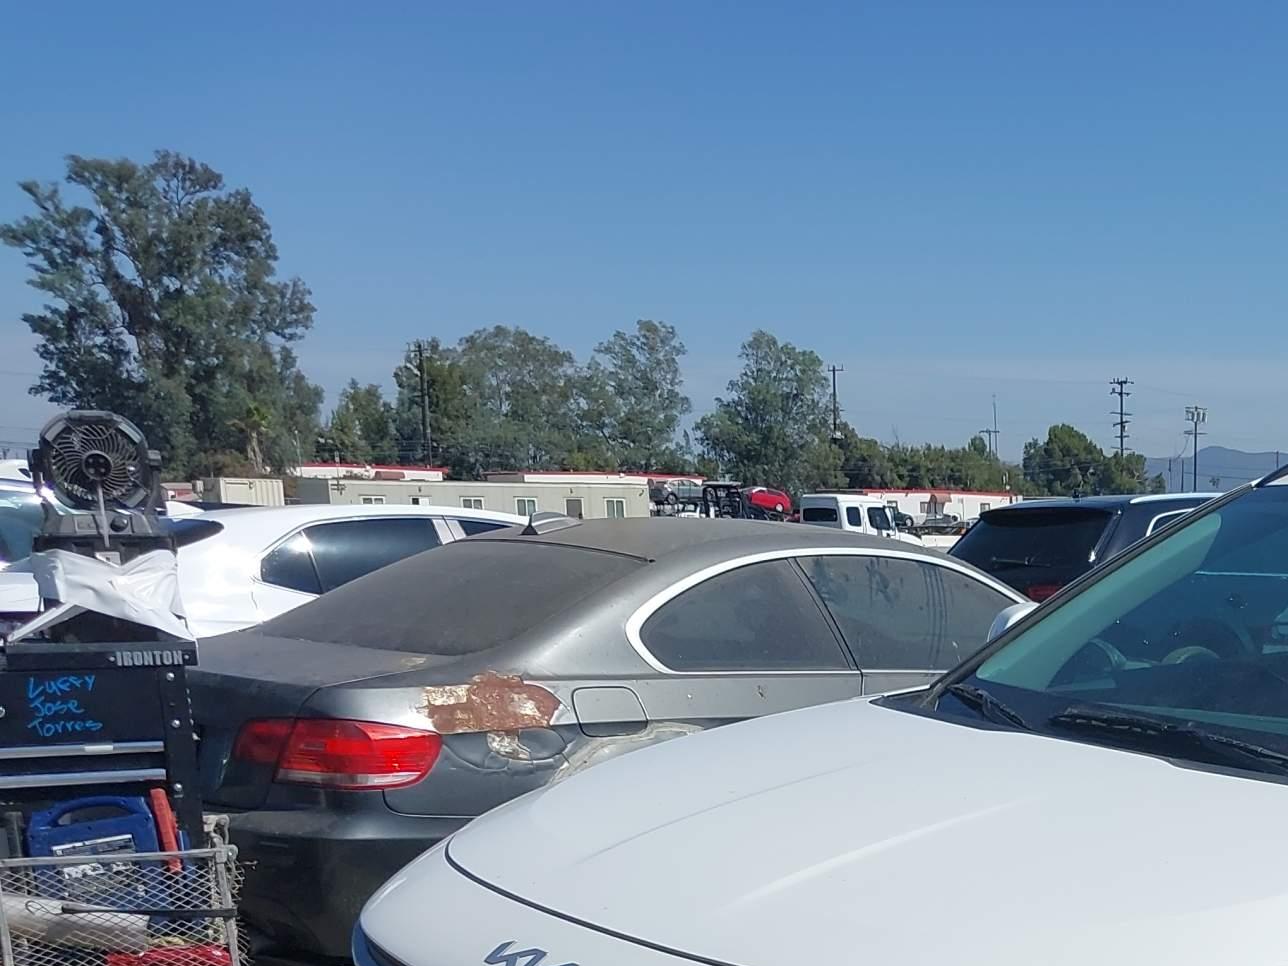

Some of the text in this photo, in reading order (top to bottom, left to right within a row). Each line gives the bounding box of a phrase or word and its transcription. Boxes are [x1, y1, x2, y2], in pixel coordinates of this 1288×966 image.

[115, 651, 183, 667] IRONTON
[30, 696, 85, 717] Jose
[27, 718, 103, 737] Torres
